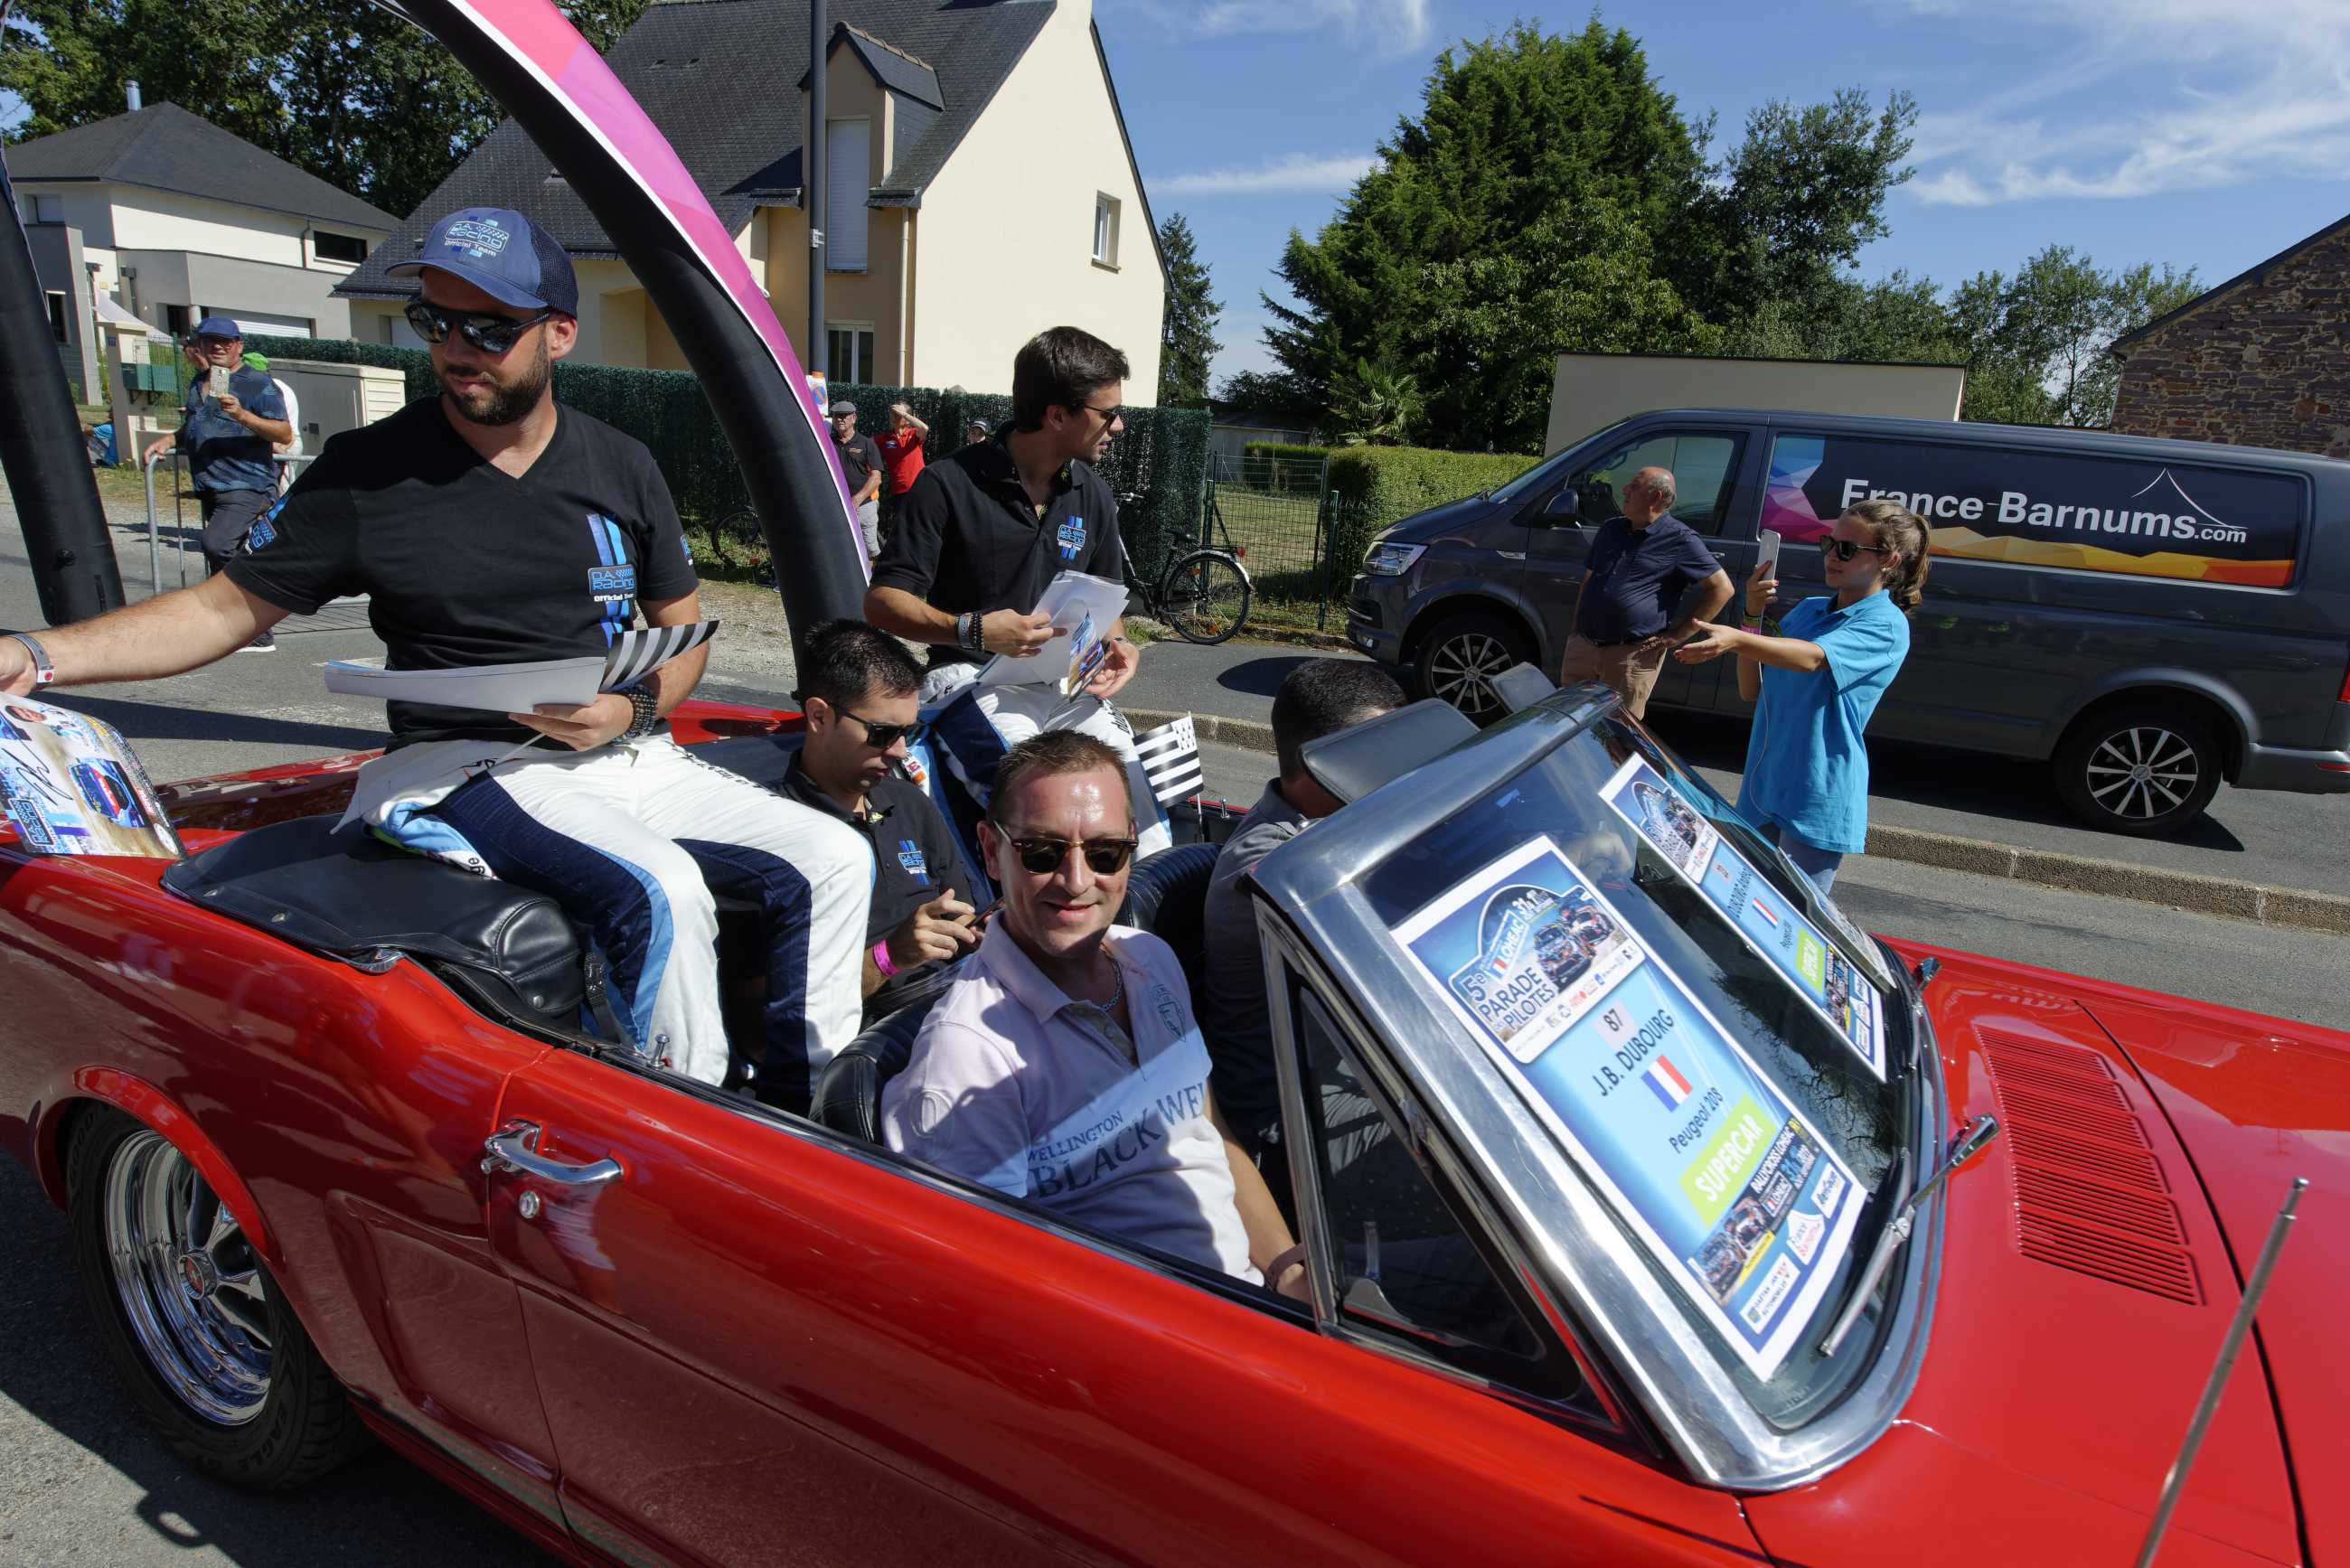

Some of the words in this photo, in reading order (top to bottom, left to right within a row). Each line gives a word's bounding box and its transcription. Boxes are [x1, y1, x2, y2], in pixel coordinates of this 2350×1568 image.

[444, 239, 471, 249] Official
[475, 243, 497, 258] Team
[446, 226, 503, 249] Racing
[594, 593, 624, 603] Official
[1460, 972, 1487, 1001] 5e
[1478, 967, 1541, 1022] PARADE
[1503, 983, 1555, 1030] PILOTES
[1603, 1009, 1623, 1032] 87
[1593, 1066, 1624, 1096] J.B.
[1616, 1009, 1674, 1071] DUBOURG
[1029, 1111, 1124, 1161] WELLINGTON
[1668, 1104, 1708, 1154] Peugeot
[1704, 1087, 1723, 1113] 208
[1029, 1108, 1161, 1198] BLACK
[1695, 1114, 1763, 1202] SUPERCAR
